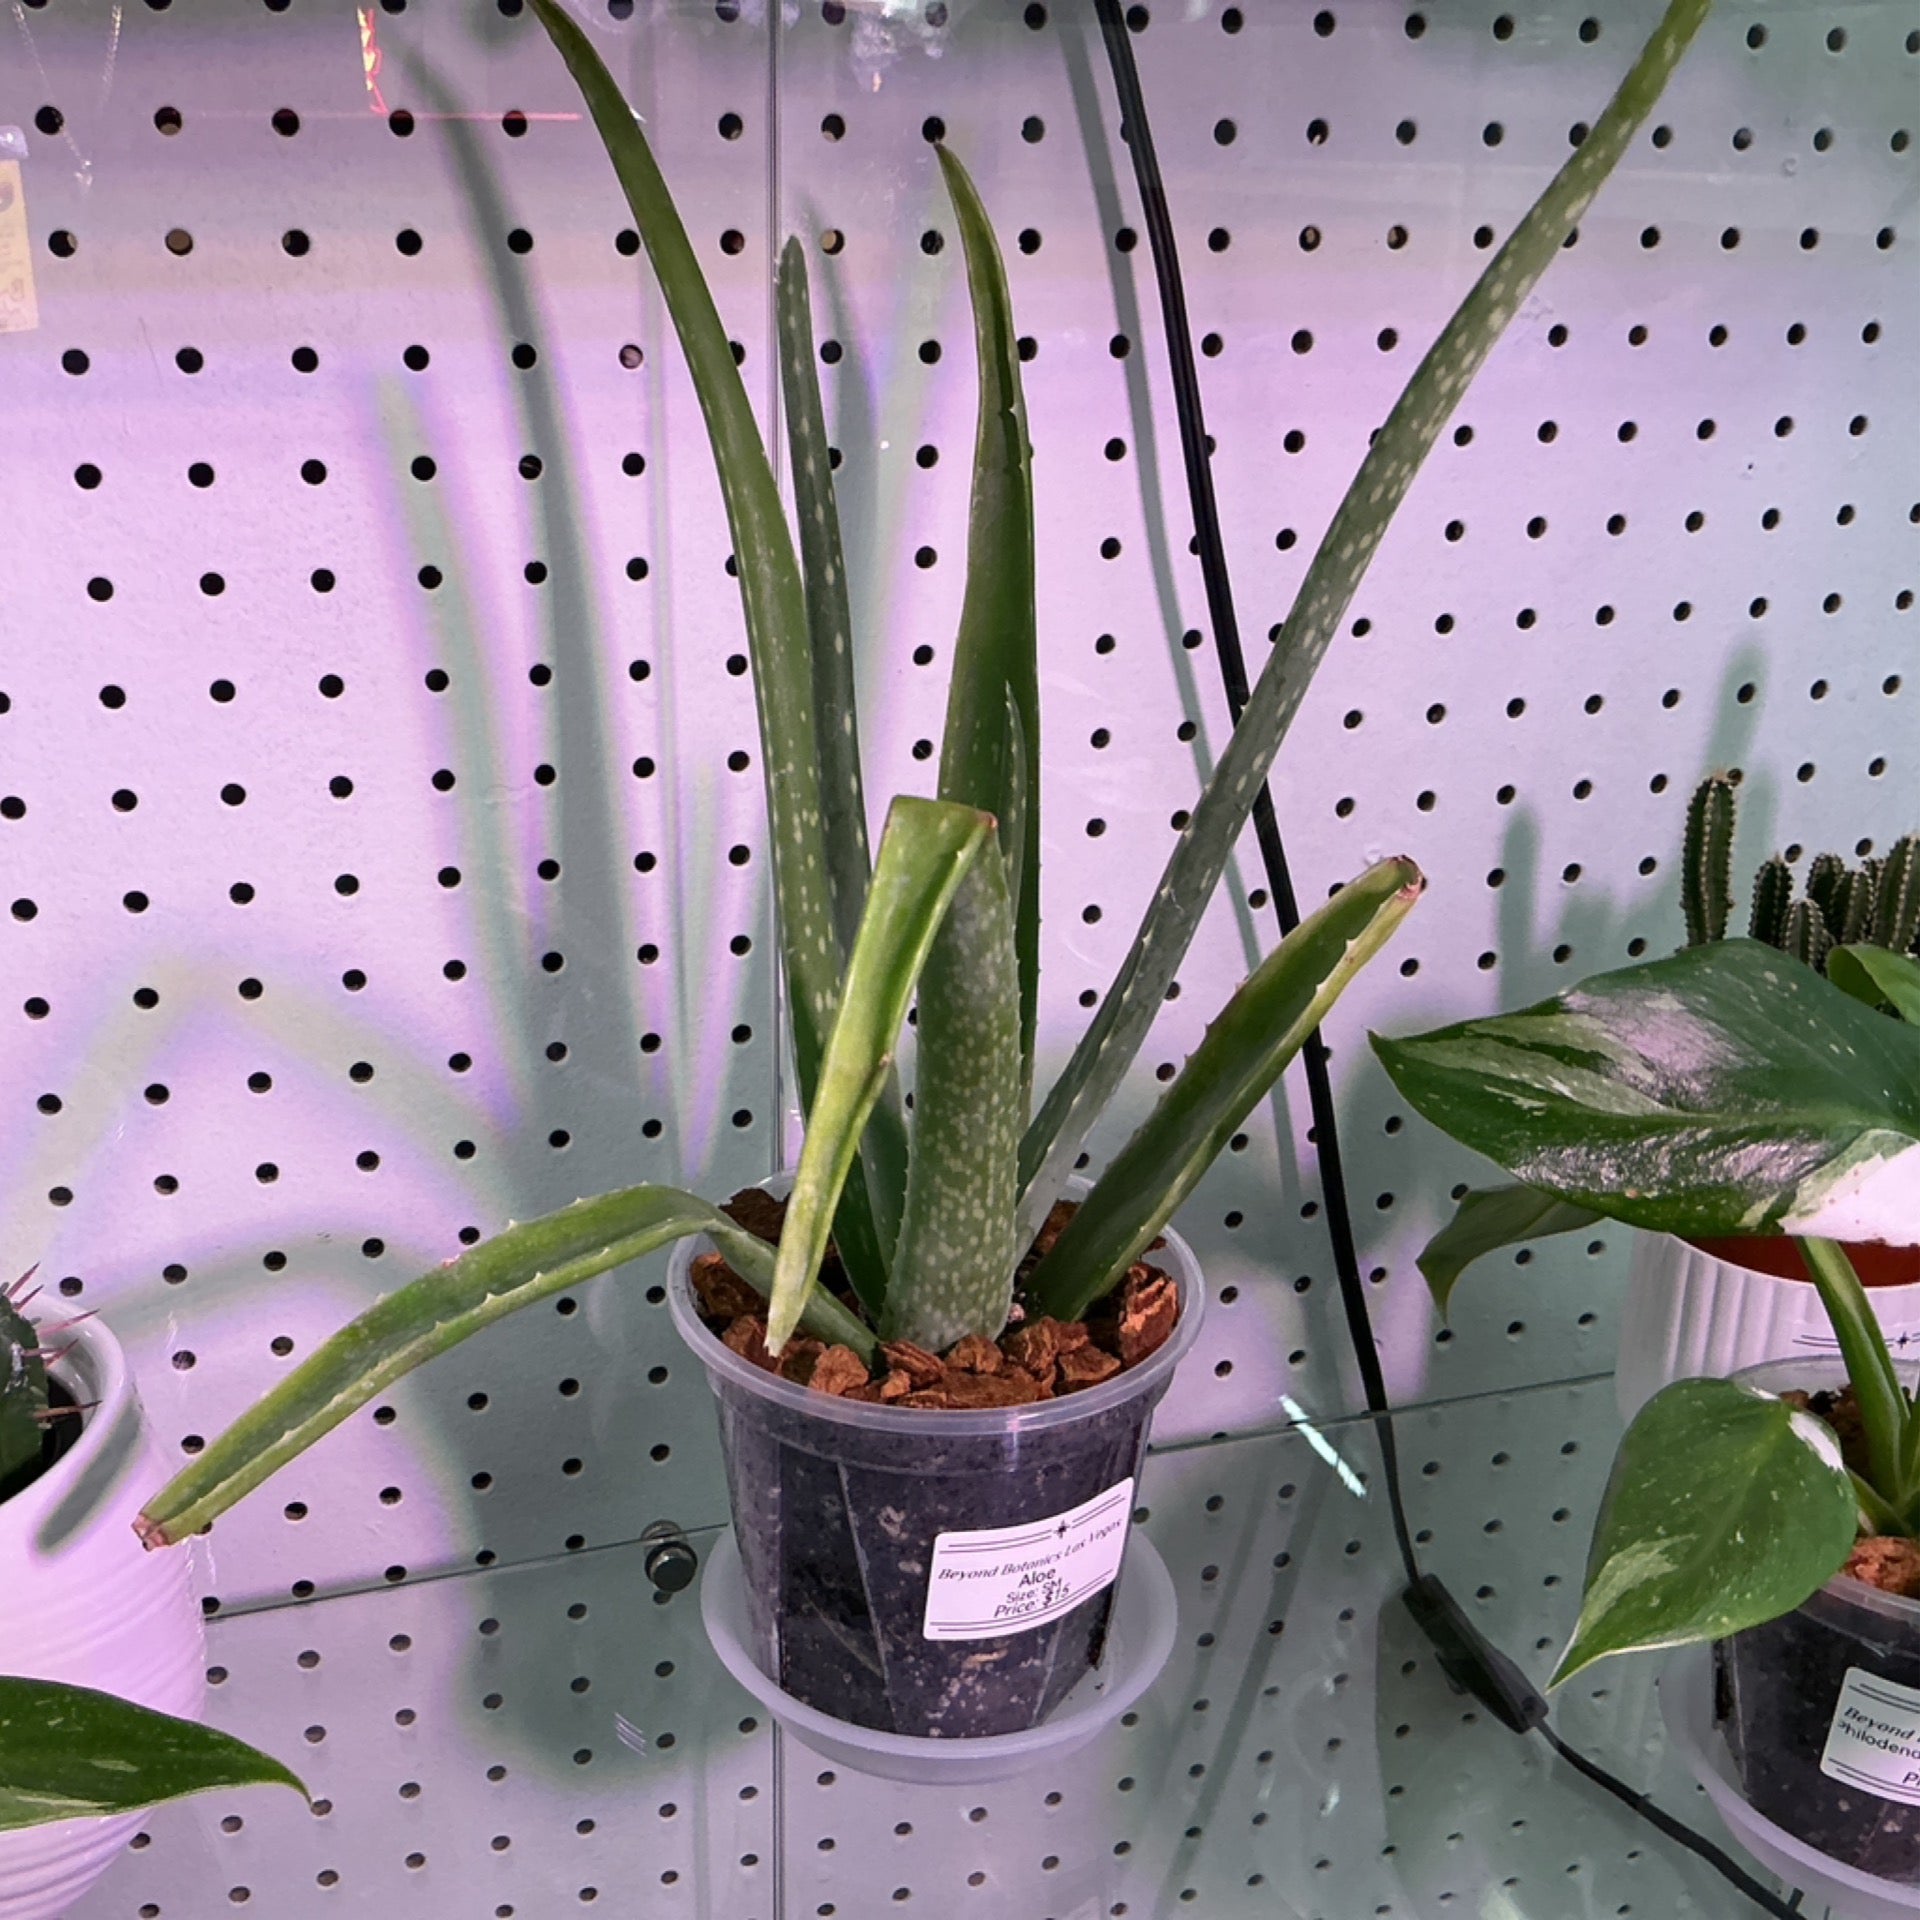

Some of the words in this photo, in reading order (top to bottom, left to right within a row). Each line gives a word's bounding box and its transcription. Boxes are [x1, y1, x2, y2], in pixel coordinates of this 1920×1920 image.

[938, 1565, 1000, 1581] Beyond
[1000, 1551, 1062, 1575] Botanics
[1064, 1539, 1086, 1557] Las
[1089, 1519, 1121, 1543] Vegas
[1006, 1587, 1040, 1604] Size:
[1018, 1568, 1056, 1588] Aloe
[993, 1598, 1040, 1618] Price:
[1042, 1582, 1070, 1608] $15
[1844, 1705, 1915, 1740] Beyond
